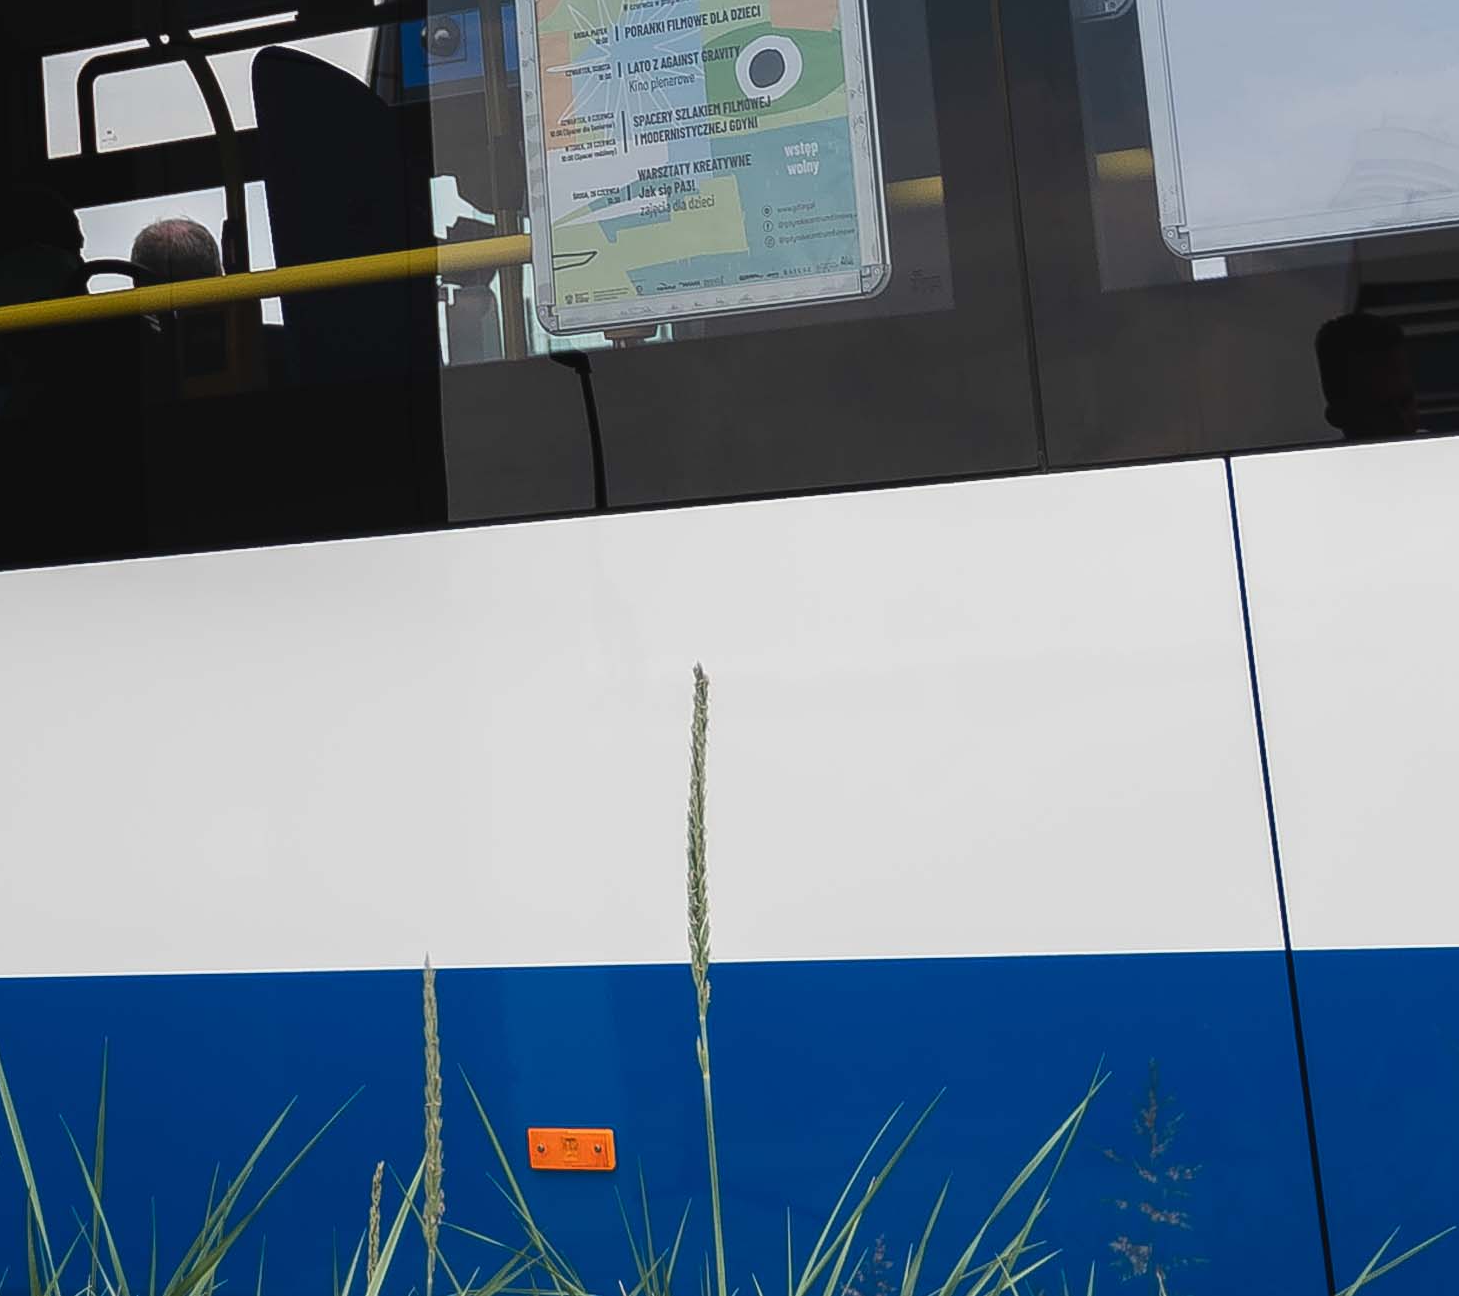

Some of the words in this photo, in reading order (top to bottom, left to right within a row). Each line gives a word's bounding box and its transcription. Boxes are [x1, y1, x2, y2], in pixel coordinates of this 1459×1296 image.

[625, 22, 666, 39] PORANKI
[667, 16, 708, 34] FILMOWE
[710, 12, 729, 26] DLA
[731, 5, 761, 21] DZIECI
[627, 59, 650, 74] LATO
[652, 58, 659, 69] Z
[660, 50, 700, 70] AGAINST
[701, 45, 741, 63] GRAVITY
[628, 78, 649, 92] Kino
[651, 72, 695, 92] plenerowe
[633, 112, 673, 128] SPACERY
[675, 103, 721, 122] SZLAKIEM
[723, 96, 772, 116] FILMOWEJ
[640, 121, 727, 145] MODERNISTYCZNEJ
[728, 116, 759, 133] GDYNI
[784, 139, 819, 160] wstęp
[637, 163, 691, 182] WARSZTATY
[693, 154, 752, 174] KREATYWNE
[787, 159, 820, 176] wolny
[638, 182, 657, 200] Jak
[658, 179, 673, 199] się
[640, 199, 670, 218] zajęcia
[671, 197, 687, 212] dla
[688, 193, 715, 210] dzieci
